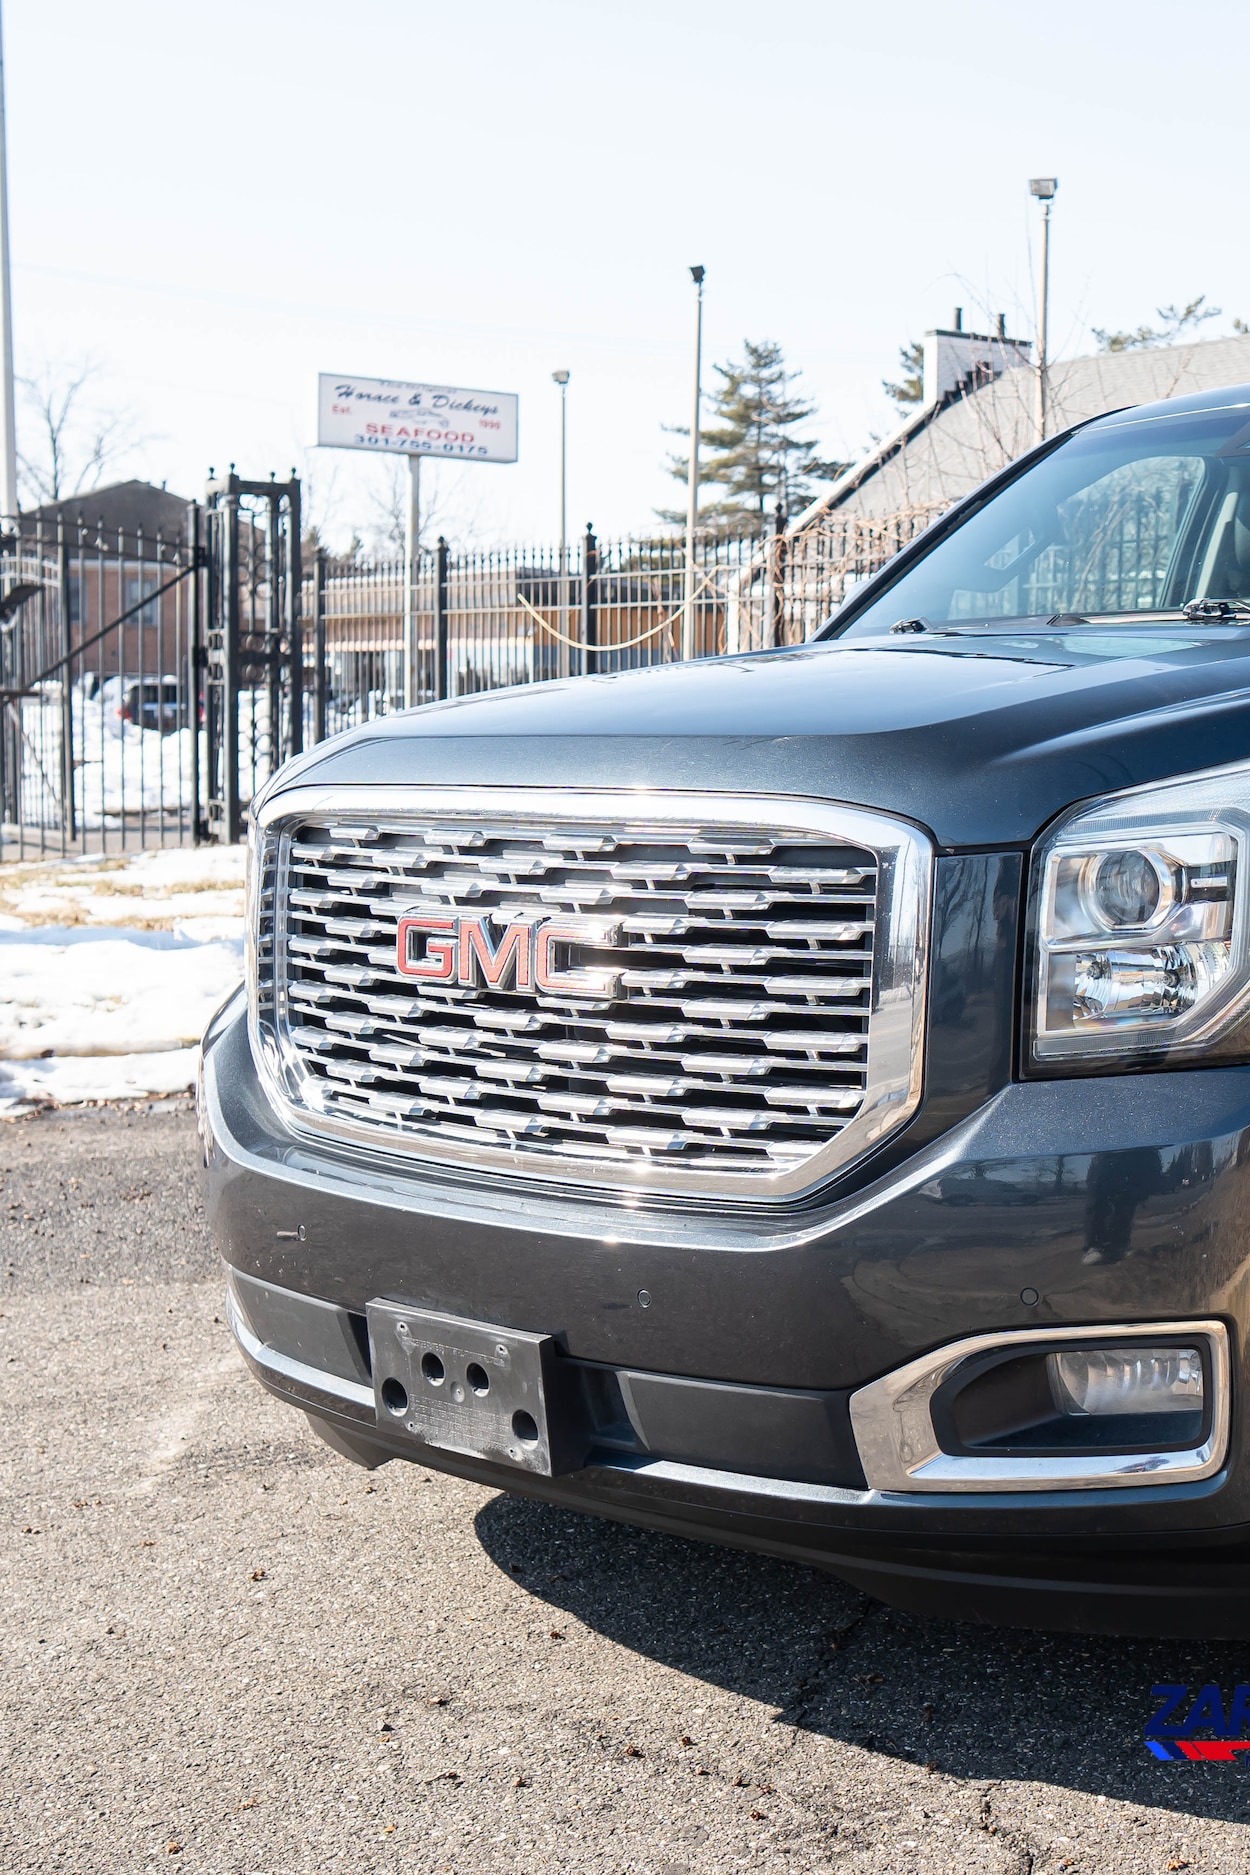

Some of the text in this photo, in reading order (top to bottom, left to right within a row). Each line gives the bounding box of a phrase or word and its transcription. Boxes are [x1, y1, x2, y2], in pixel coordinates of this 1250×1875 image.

[334, 384, 399, 405] Horace
[408, 393, 421, 407] &
[365, 423, 475, 444] SEAFOOD
[396, 911, 626, 999] GMC
